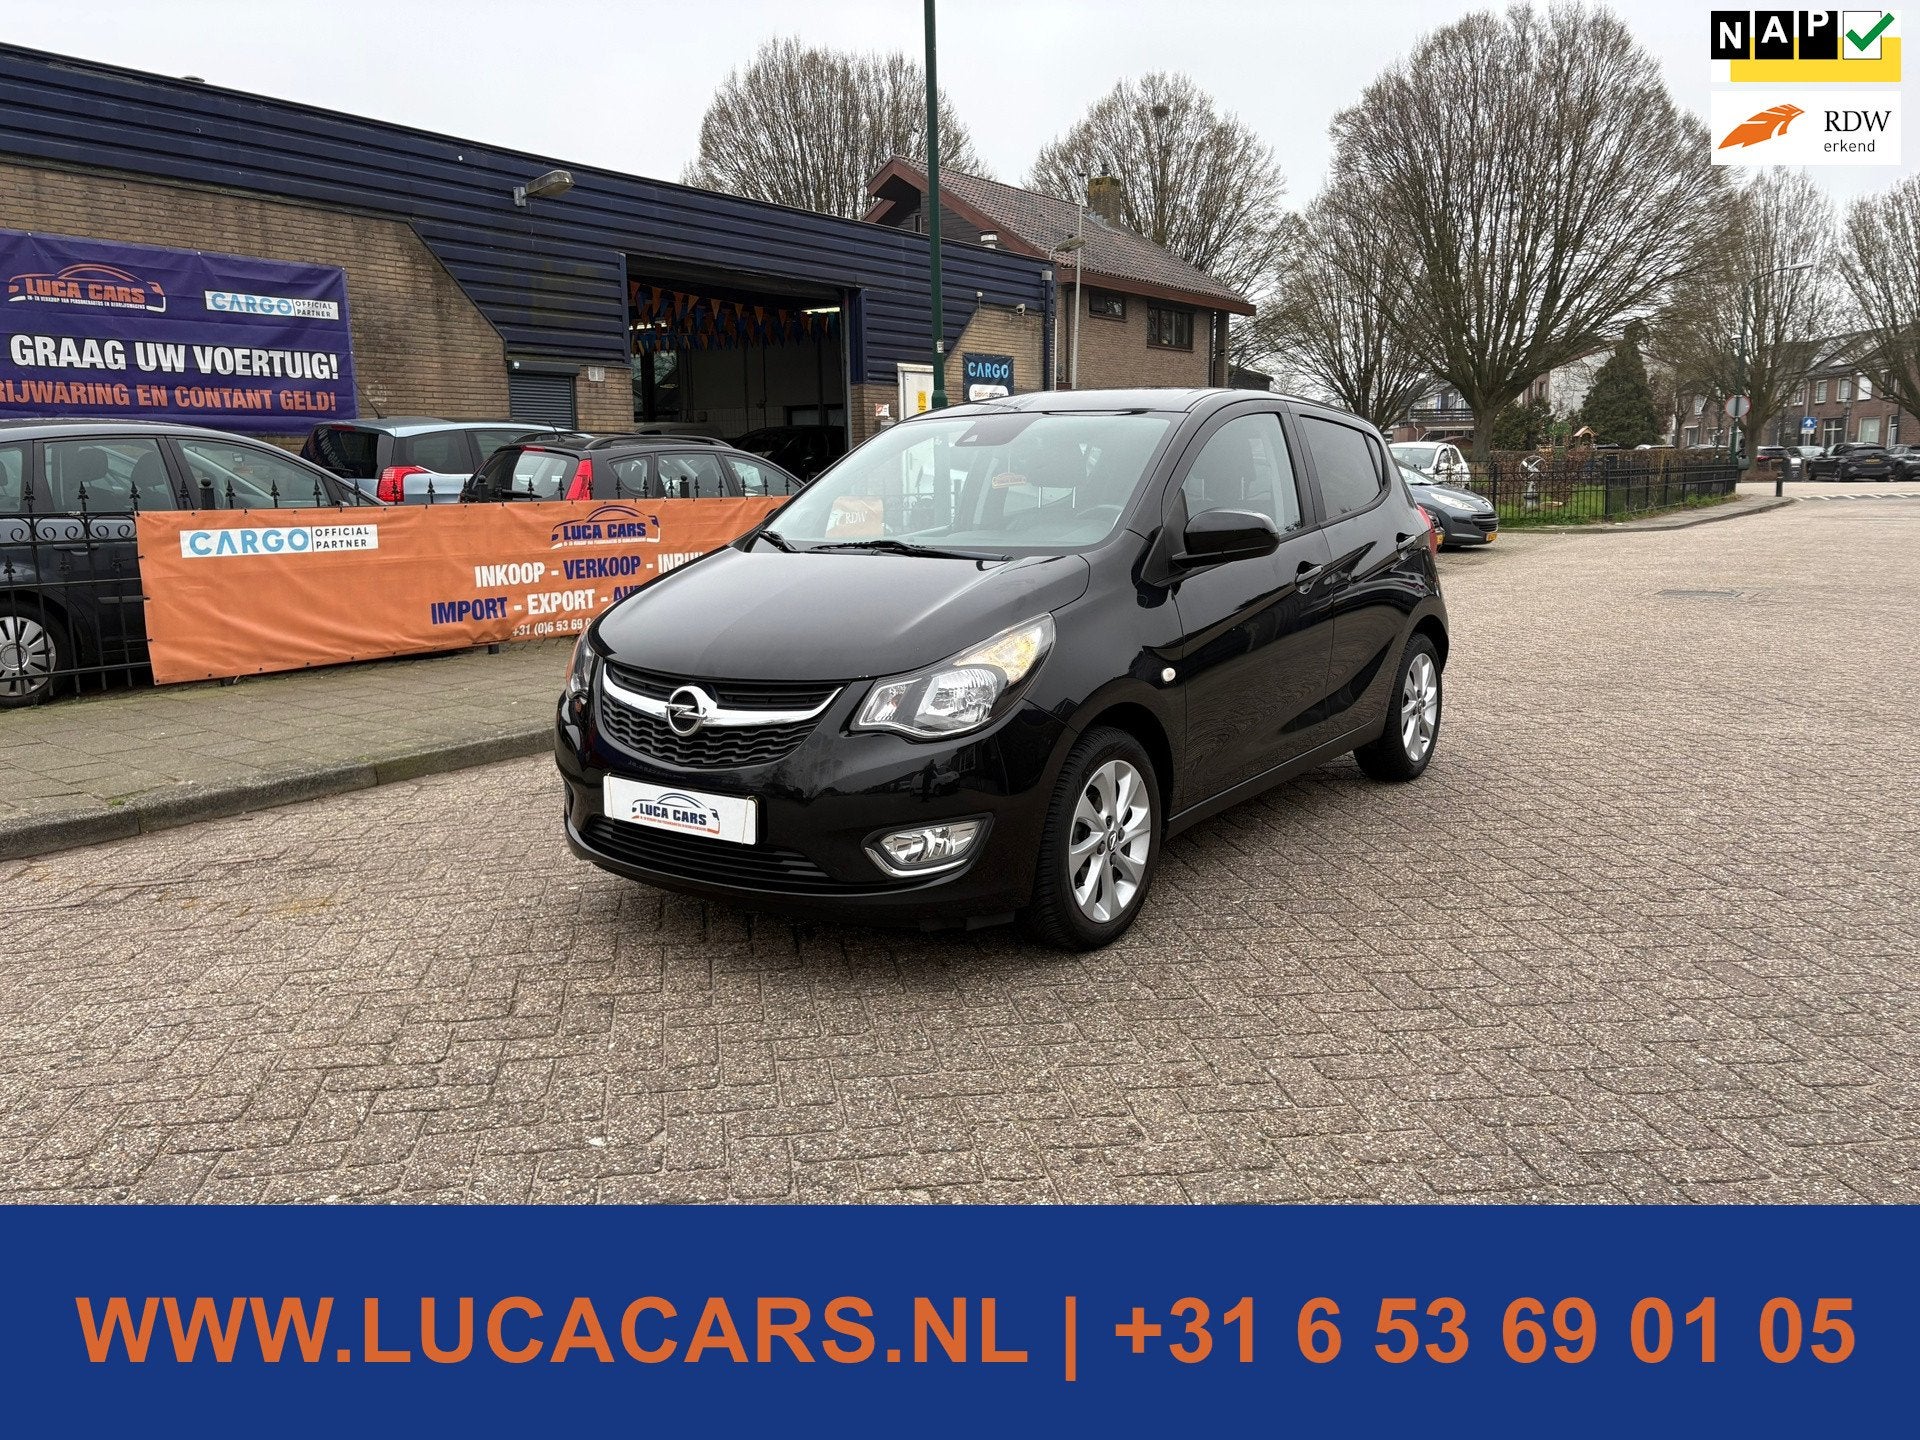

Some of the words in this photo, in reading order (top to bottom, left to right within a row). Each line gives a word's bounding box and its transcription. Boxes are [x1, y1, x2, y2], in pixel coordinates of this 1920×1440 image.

[25, 278, 82, 299] LUCA
[88, 283, 145, 304] CARS
[211, 293, 292, 315] CARGO
[295, 301, 332, 310] OFFICIAL
[297, 309, 331, 318] PARTNER
[10, 335, 126, 370] GRAAG
[136, 342, 185, 373] UW
[194, 345, 339, 380] VOERTUIG!
[968, 362, 1009, 379] CARGO
[137, 385, 167, 407] EN
[175, 387, 272, 411] CONTANT
[280, 390, 336, 412] GELD!
[189, 528, 309, 556] CARGO
[315, 527, 369, 538] OFFICIAL
[563, 524, 602, 541] LUCA
[607, 523, 646, 538] CARS
[316, 538, 367, 550] PARTNER
[474, 562, 545, 588] INKOOP
[563, 555, 641, 580] VERKOOP
[431, 597, 508, 625] IMPORT
[526, 589, 595, 615] EXPORT
[512, 624, 531, 637] +31
[534, 621, 554, 636] (0)6
[556, 620, 568, 632] 53
[571, 618, 583, 630] 69
[639, 803, 669, 819] LUCA
[673, 809, 707, 826] CARS
